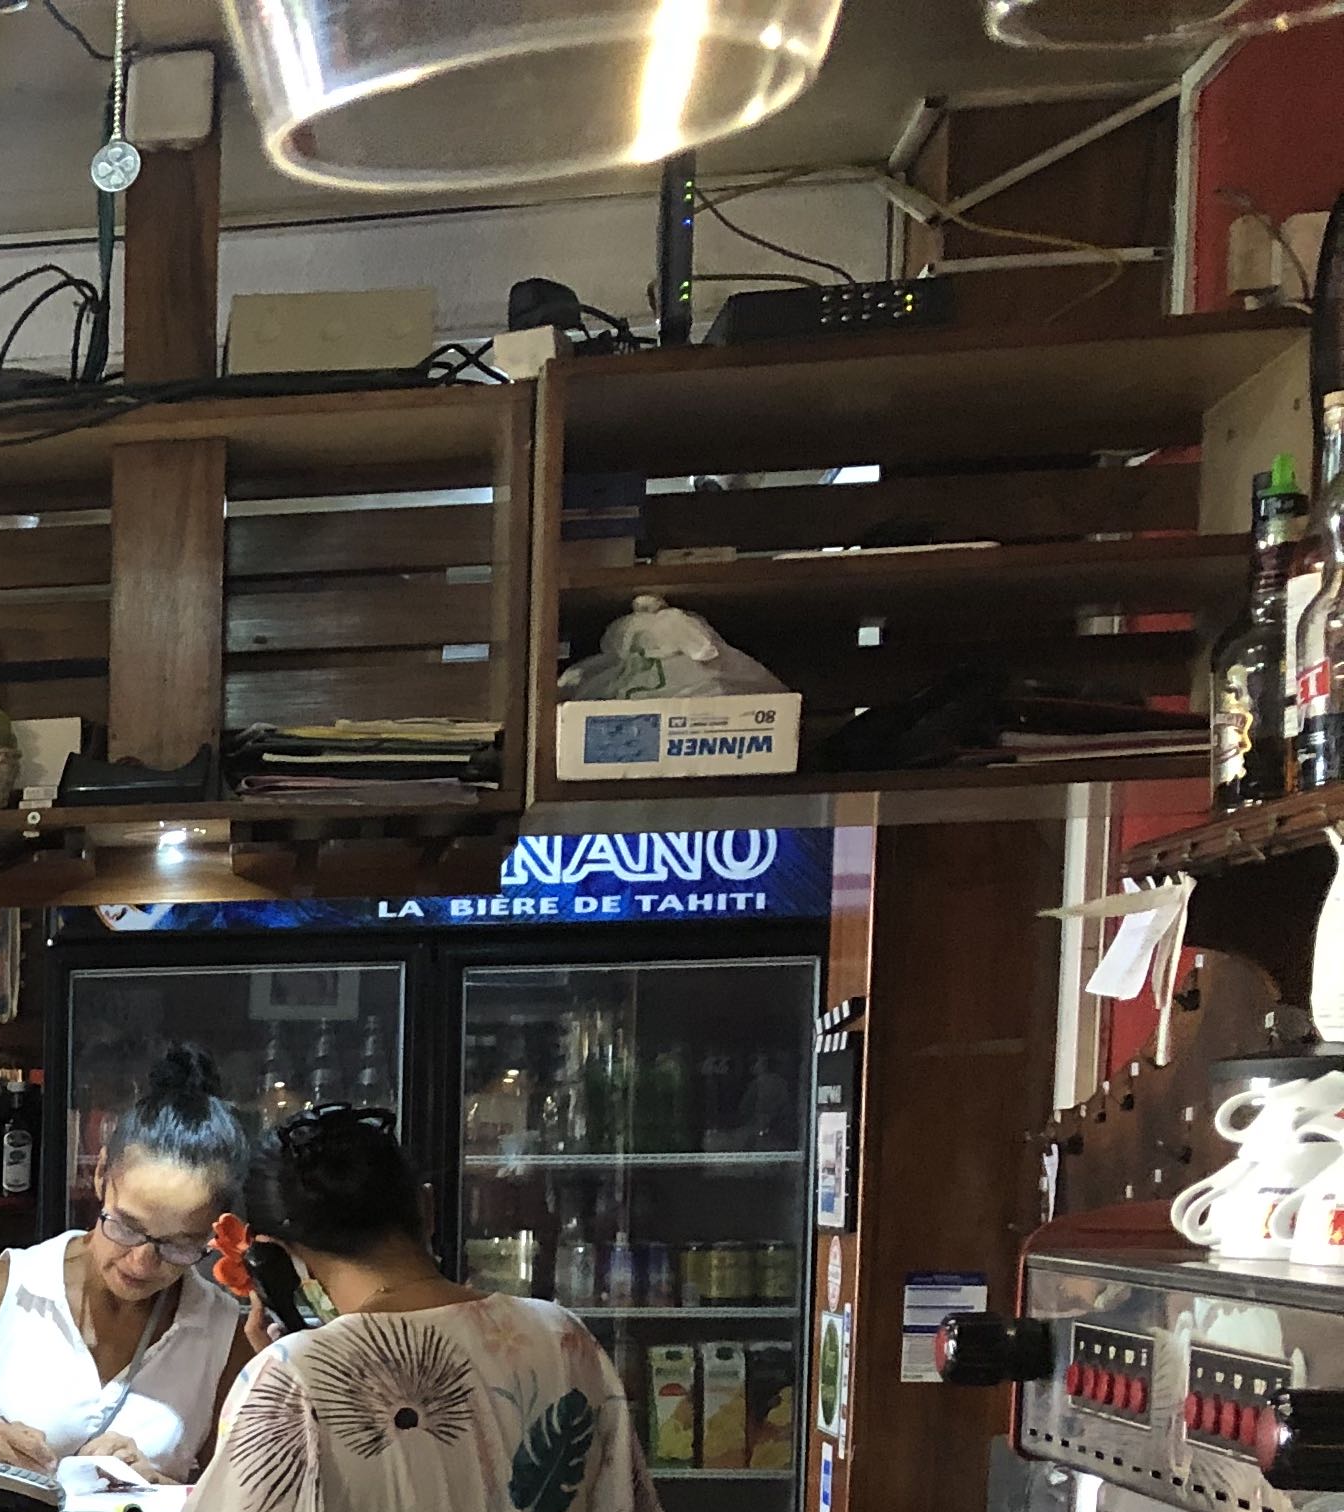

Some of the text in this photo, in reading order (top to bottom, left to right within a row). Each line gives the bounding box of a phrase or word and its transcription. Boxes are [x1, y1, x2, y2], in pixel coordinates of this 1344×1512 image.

[378, 892, 766, 918] LA BIÈRE DE TAHITI
